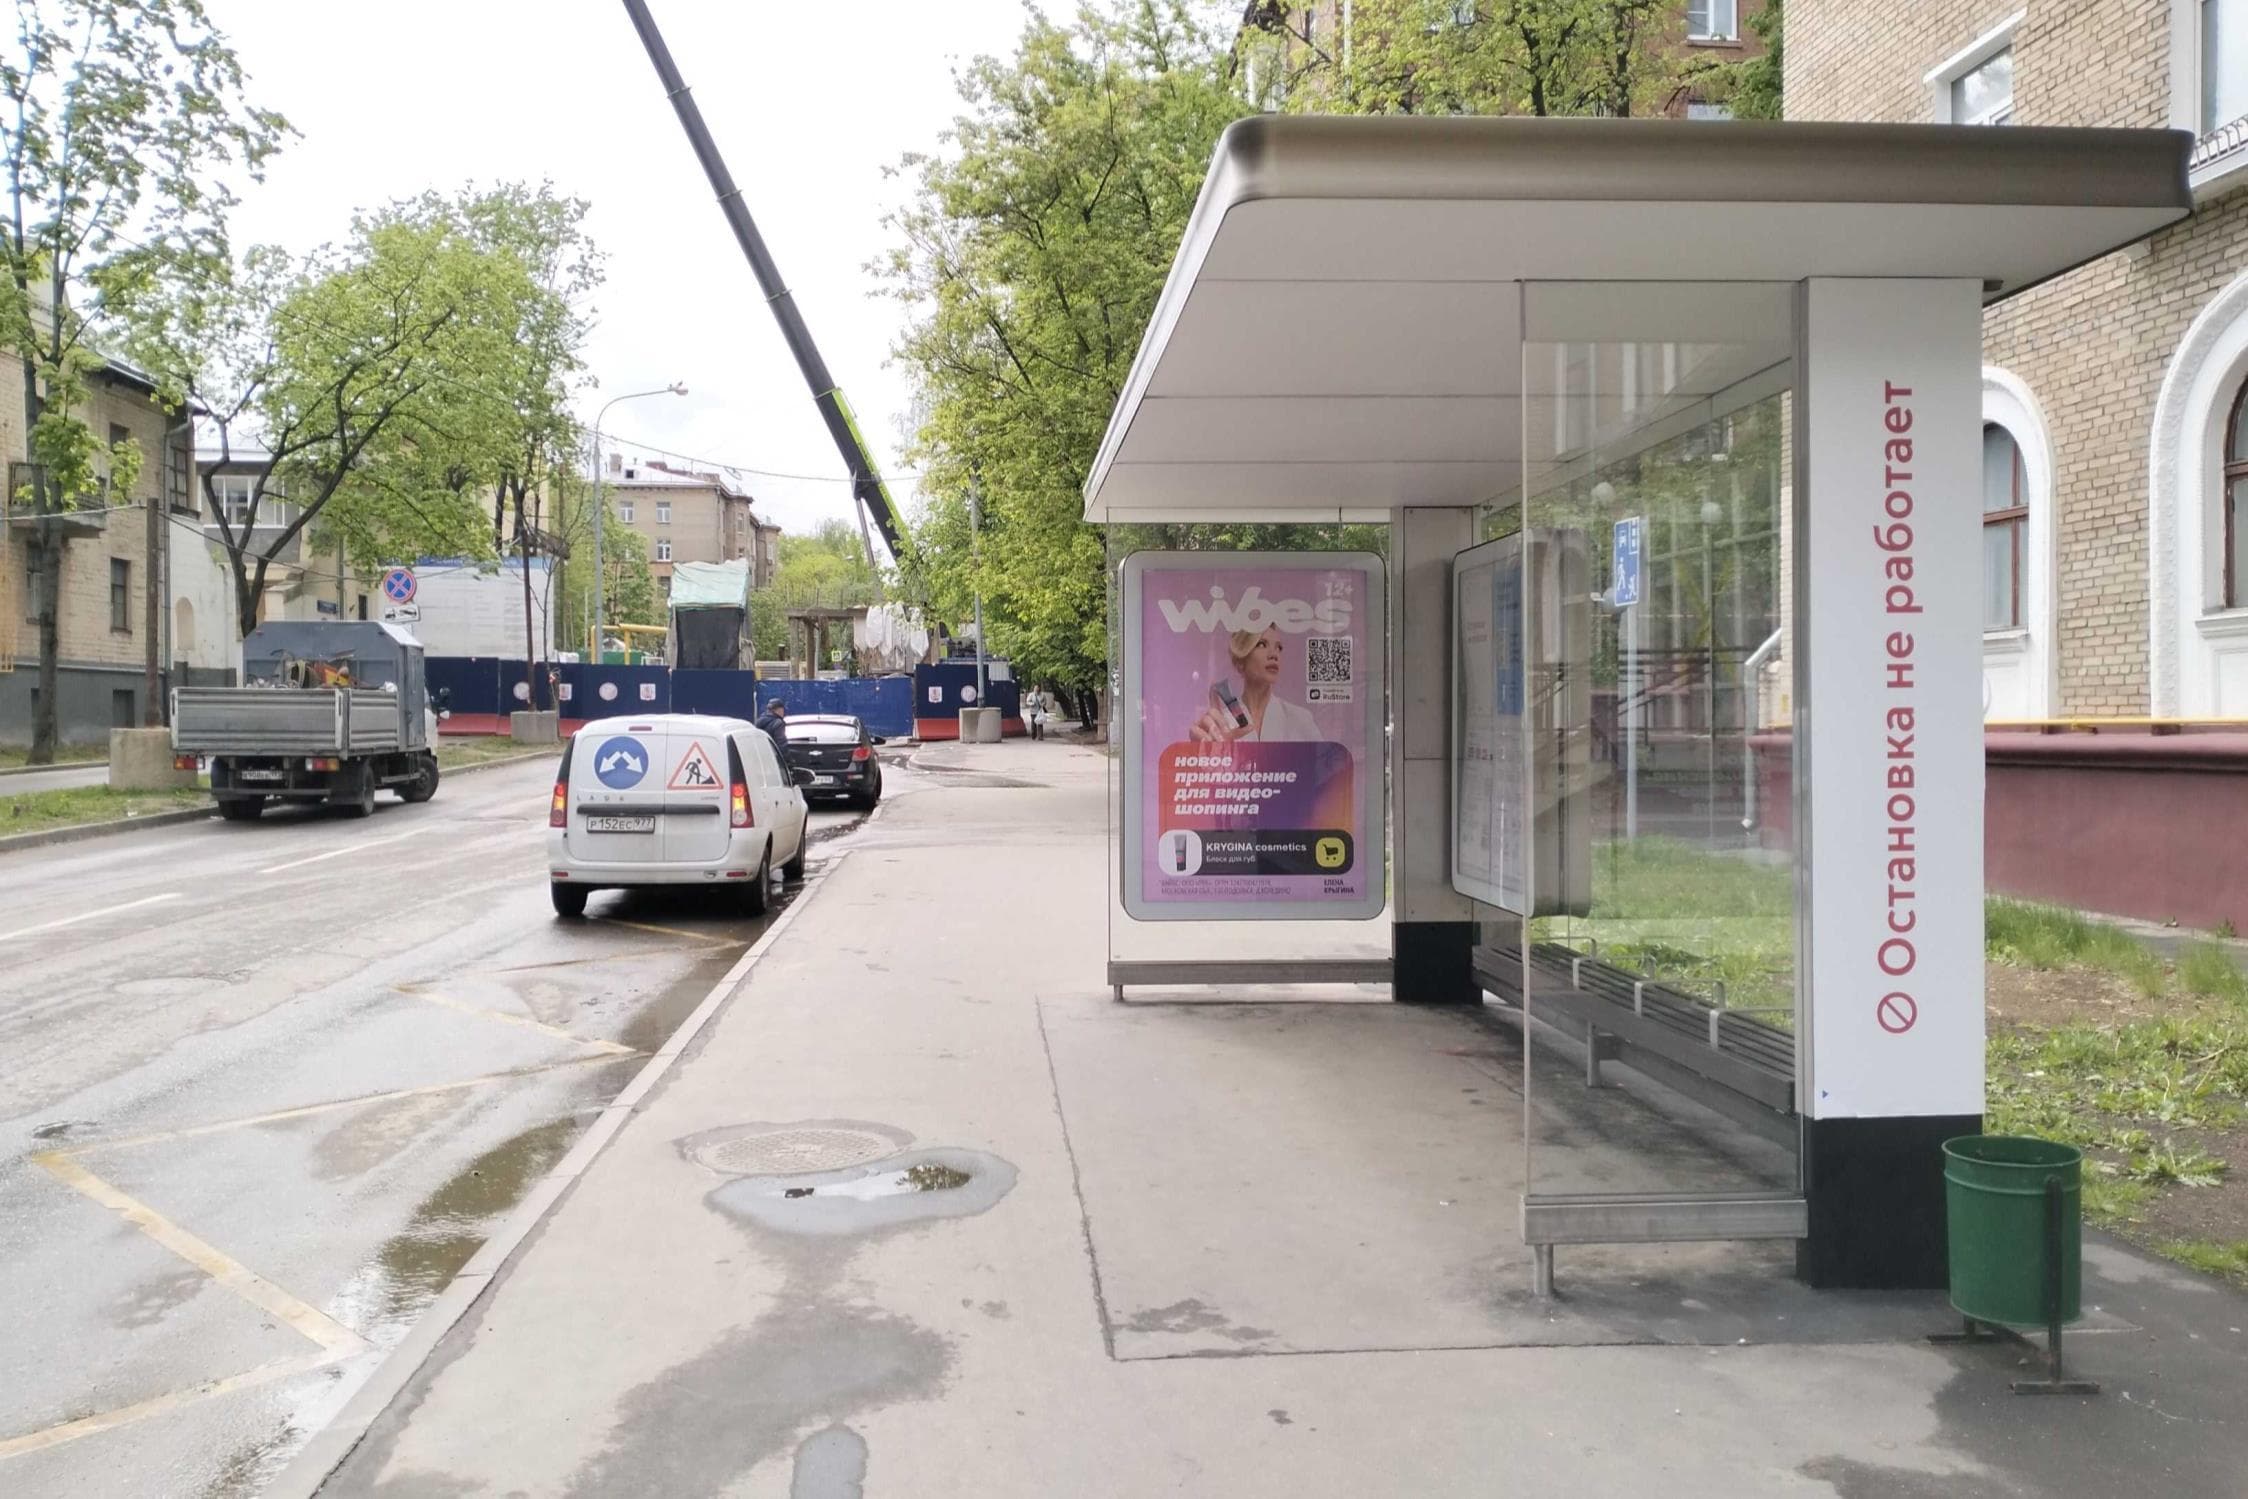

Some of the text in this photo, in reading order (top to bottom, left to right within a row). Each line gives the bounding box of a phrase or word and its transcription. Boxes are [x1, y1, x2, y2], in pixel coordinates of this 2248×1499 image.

[1324, 582, 1353, 597] 12+
[1873, 380, 1924, 977] Остановка не работает
[1174, 756, 1232, 767] новое
[1174, 772, 1297, 787] приложение
[1174, 787, 1281, 801] для видео-
[1174, 803, 1260, 815] шопинга
[1206, 842, 1307, 852] KRYGINA cosmetics
[1243, 855, 1256, 864] губ
